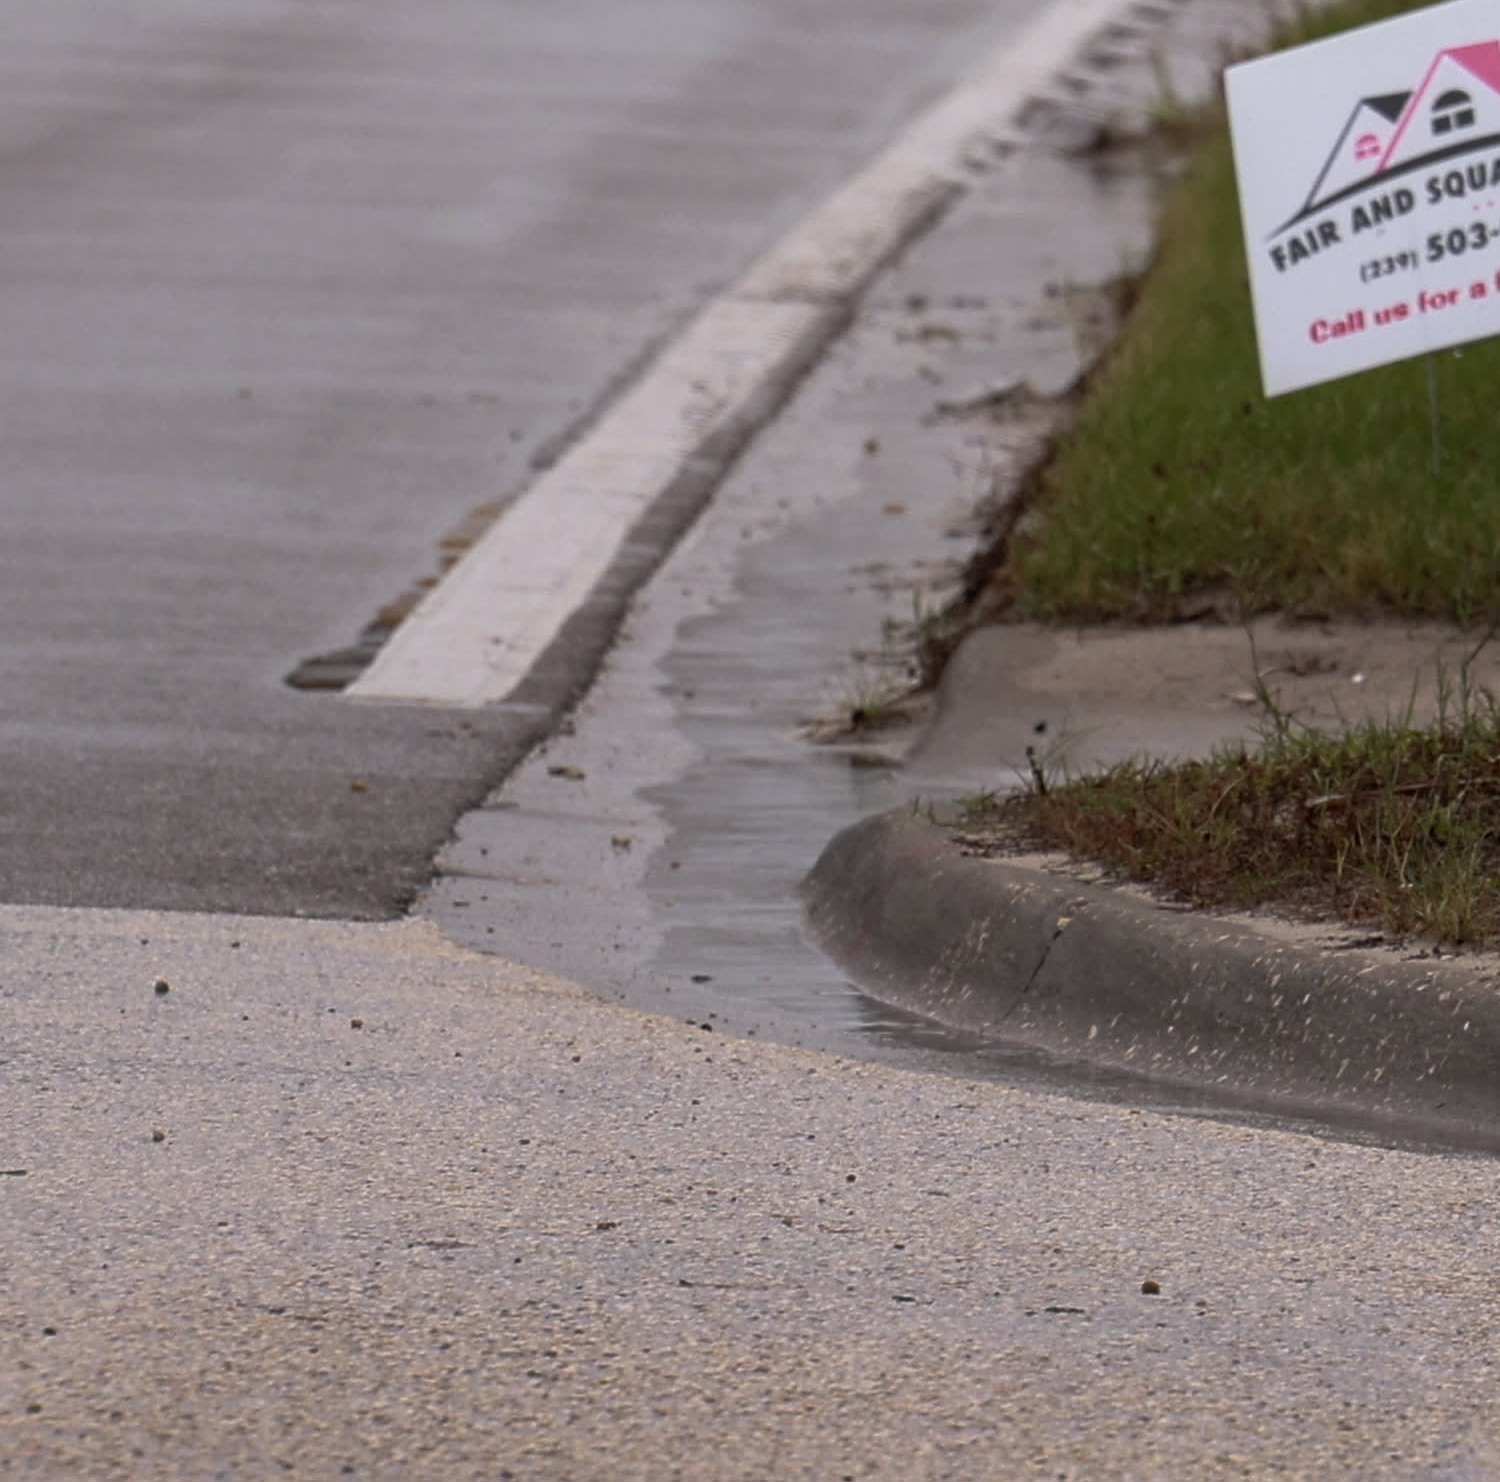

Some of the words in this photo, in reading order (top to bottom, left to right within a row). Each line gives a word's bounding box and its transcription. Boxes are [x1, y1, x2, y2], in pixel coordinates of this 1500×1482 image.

[1268, 217, 1341, 274] FAIR
[1350, 188, 1415, 237] AND
[1360, 247, 1422, 285] (239)
[1308, 307, 1366, 345] Call
[1374, 300, 1410, 327] us
[1418, 285, 1459, 316] for
[1469, 278, 1487, 302] a
